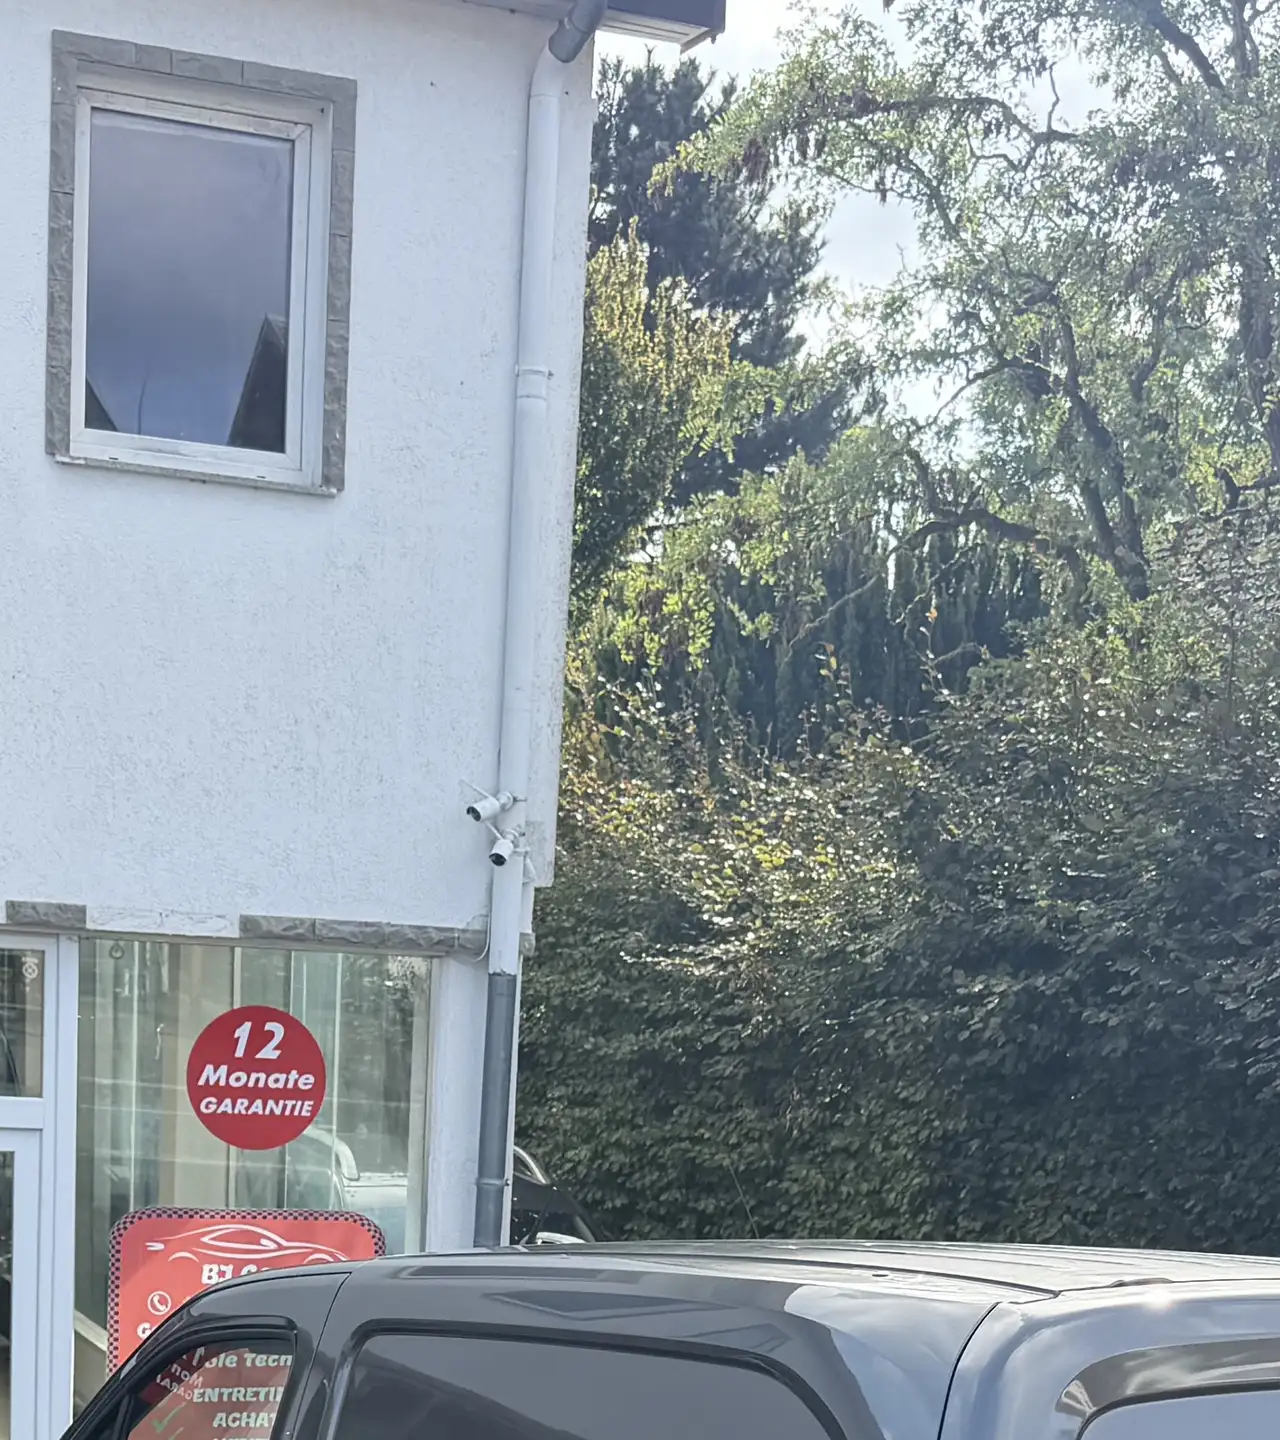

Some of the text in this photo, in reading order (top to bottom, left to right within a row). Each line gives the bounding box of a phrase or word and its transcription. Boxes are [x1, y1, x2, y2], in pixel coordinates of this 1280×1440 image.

[233, 1021, 285, 1059] 12
[197, 1064, 315, 1090] Monate
[199, 1096, 315, 1117] GARANTIE
